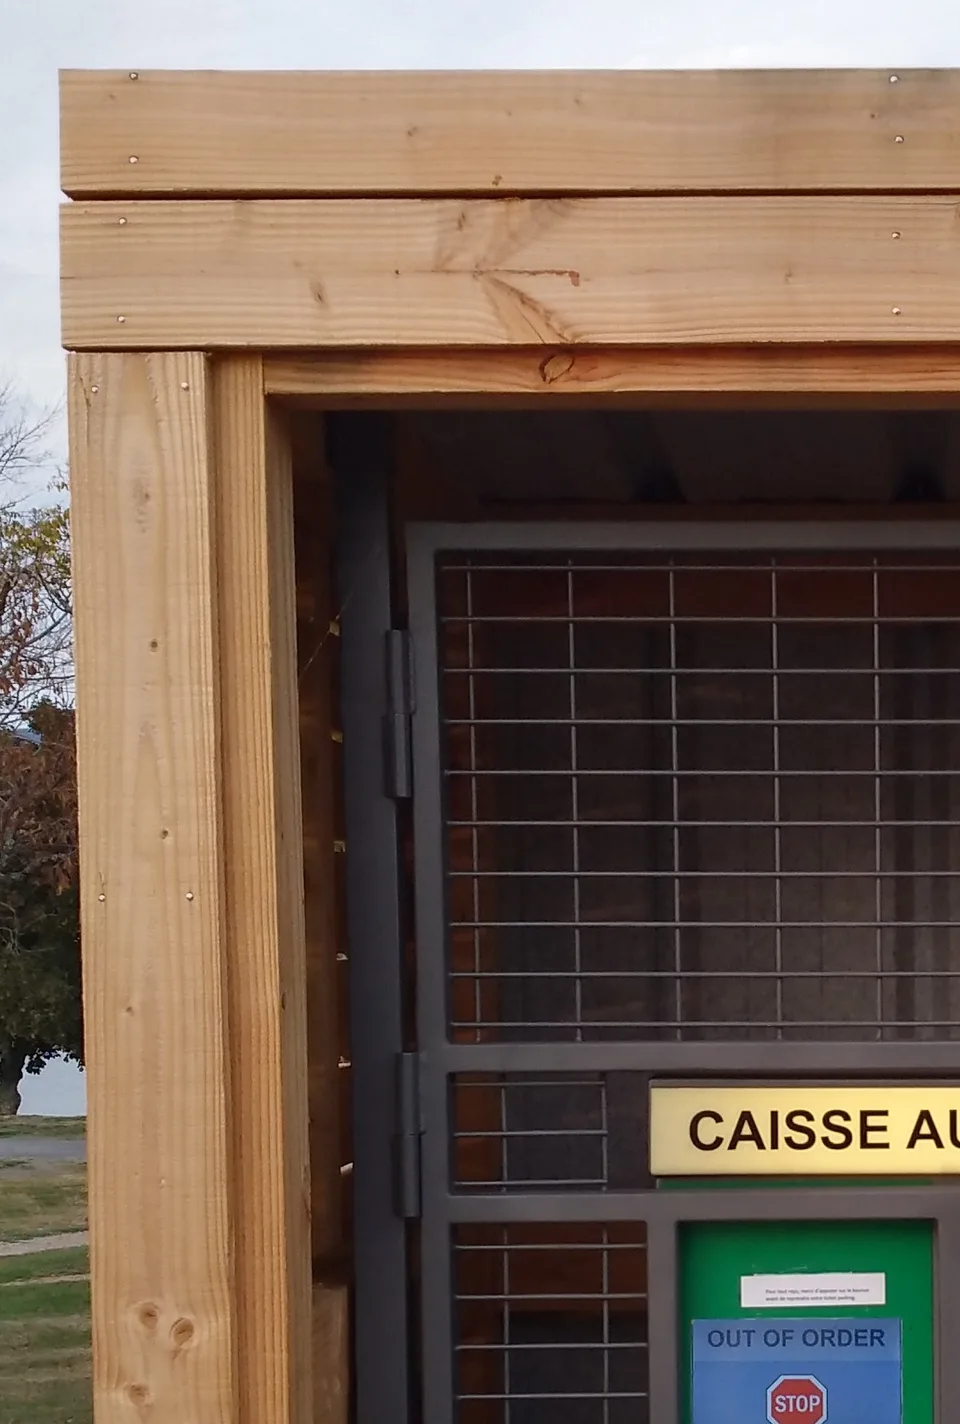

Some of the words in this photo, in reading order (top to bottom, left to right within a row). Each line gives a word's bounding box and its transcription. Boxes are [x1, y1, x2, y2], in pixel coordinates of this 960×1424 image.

[689, 1109, 890, 1151] CAISSE
[708, 1329, 756, 1347] OUT
[763, 1329, 795, 1347] OF
[802, 1329, 885, 1347] ORDER
[775, 1395, 820, 1412] STOP
